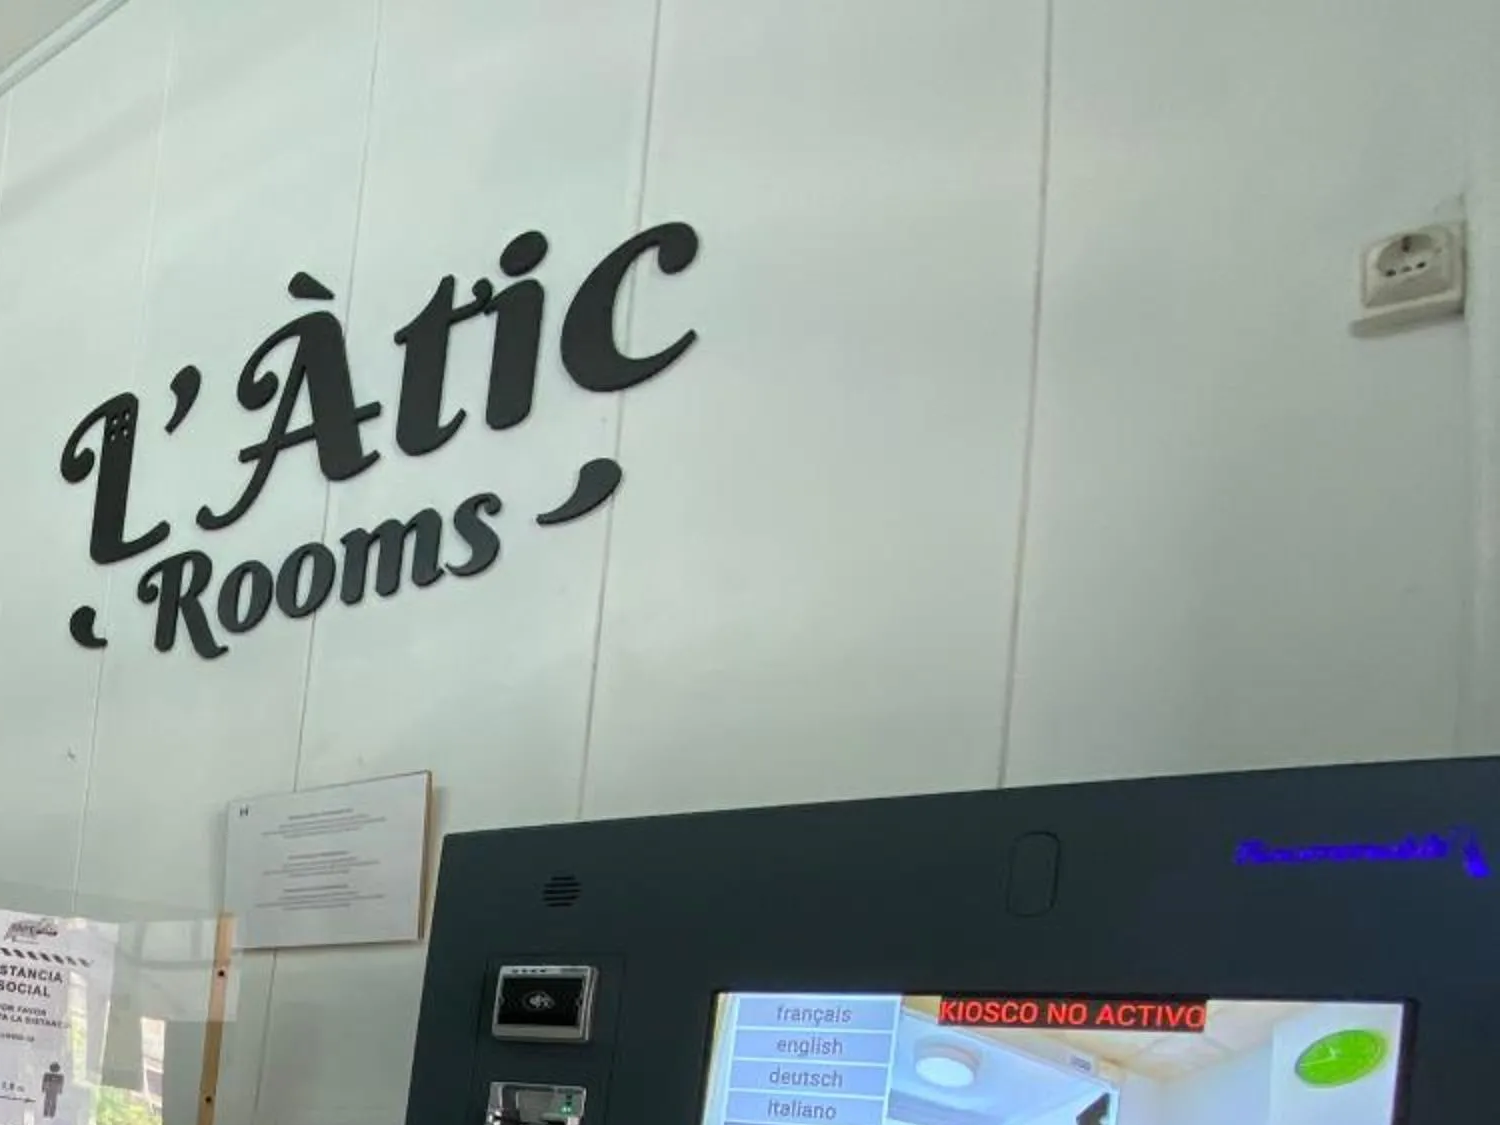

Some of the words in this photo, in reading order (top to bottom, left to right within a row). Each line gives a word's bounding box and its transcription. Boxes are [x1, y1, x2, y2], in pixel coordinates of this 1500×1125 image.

[60, 222, 699, 565] L'Àtic
[137, 492, 502, 660] Rooms
[776, 1004, 852, 1026] français
[940, 1000, 1038, 1025] KIOSCO
[1047, 1002, 1088, 1026] NO
[1095, 1004, 1206, 1029] ACTIVO
[776, 1037, 843, 1057] english
[769, 1067, 843, 1088] deutsch
[766, 1098, 837, 1121] italiano
